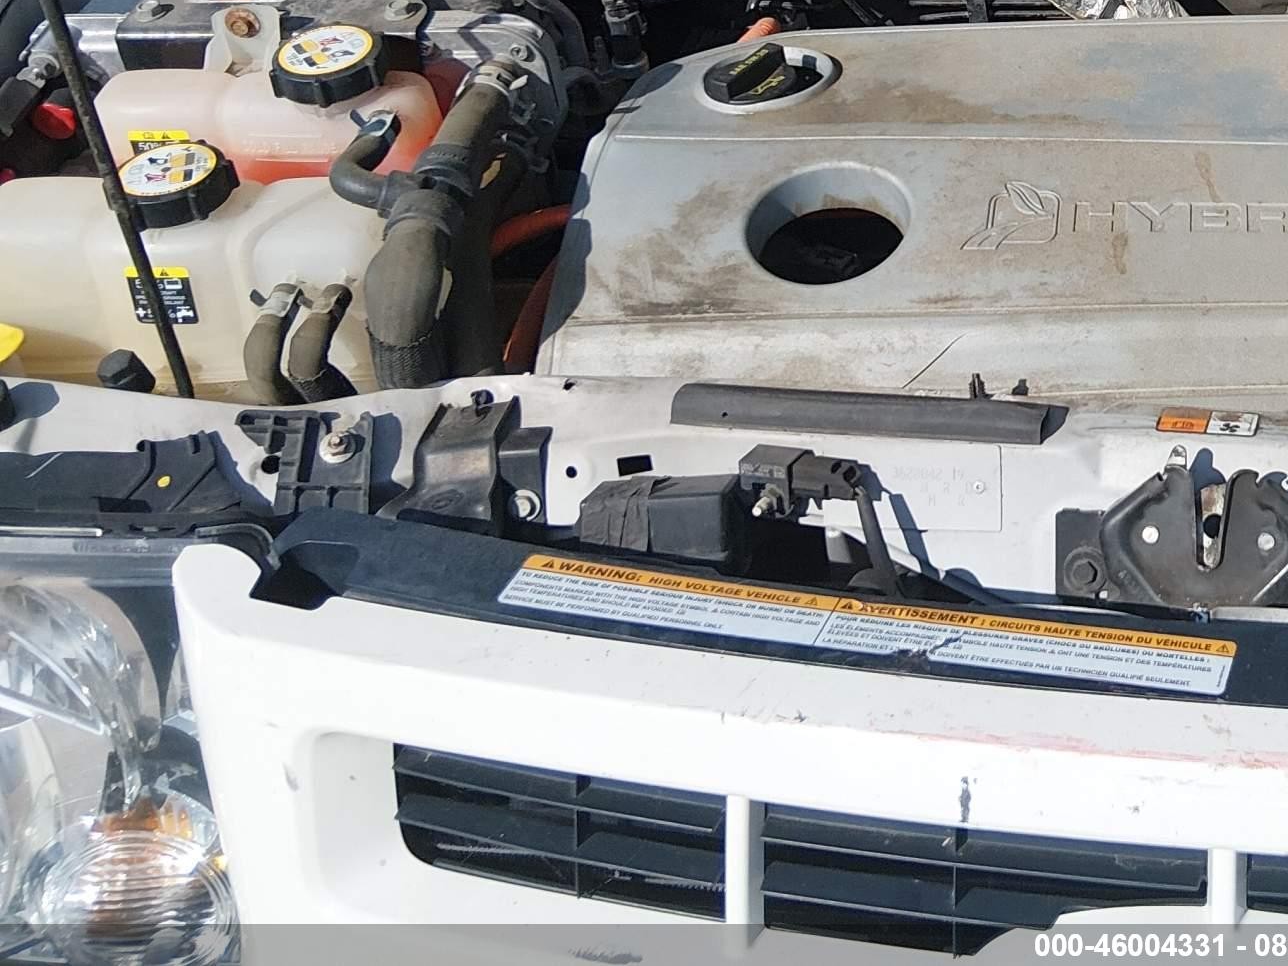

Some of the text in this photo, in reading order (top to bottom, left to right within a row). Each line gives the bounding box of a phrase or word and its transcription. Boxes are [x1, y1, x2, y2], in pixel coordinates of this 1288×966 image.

[560, 561, 802, 603] WARNING: HIGH VOLTAGE VEHICLE
[989, 620, 1041, 633] CIRCUITS
[1043, 627, 1082, 637] HAUTE
[1085, 631, 1133, 642] TENSION
[1156, 637, 1212, 651] VÉHICULE
